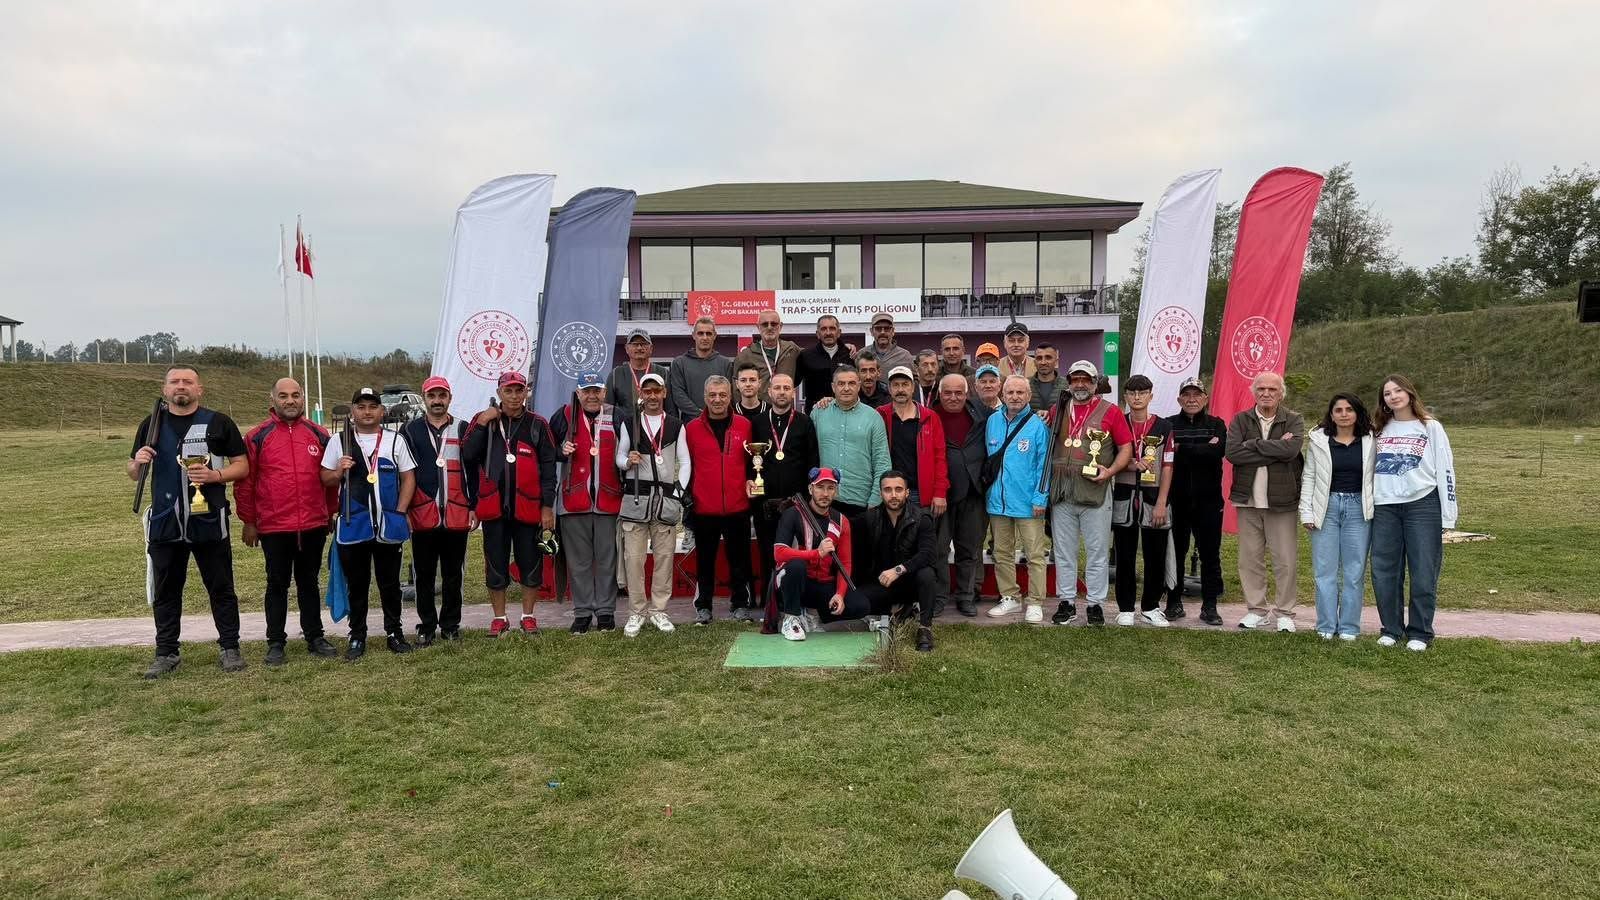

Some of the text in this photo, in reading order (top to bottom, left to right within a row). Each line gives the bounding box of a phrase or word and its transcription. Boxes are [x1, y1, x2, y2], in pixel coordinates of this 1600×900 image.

[732, 299, 760, 308] GENÇLİK
[782, 303, 916, 315] TRAP-SKEET ATIŞ POLİGONU
[1393, 438, 1425, 446] WHEELS
